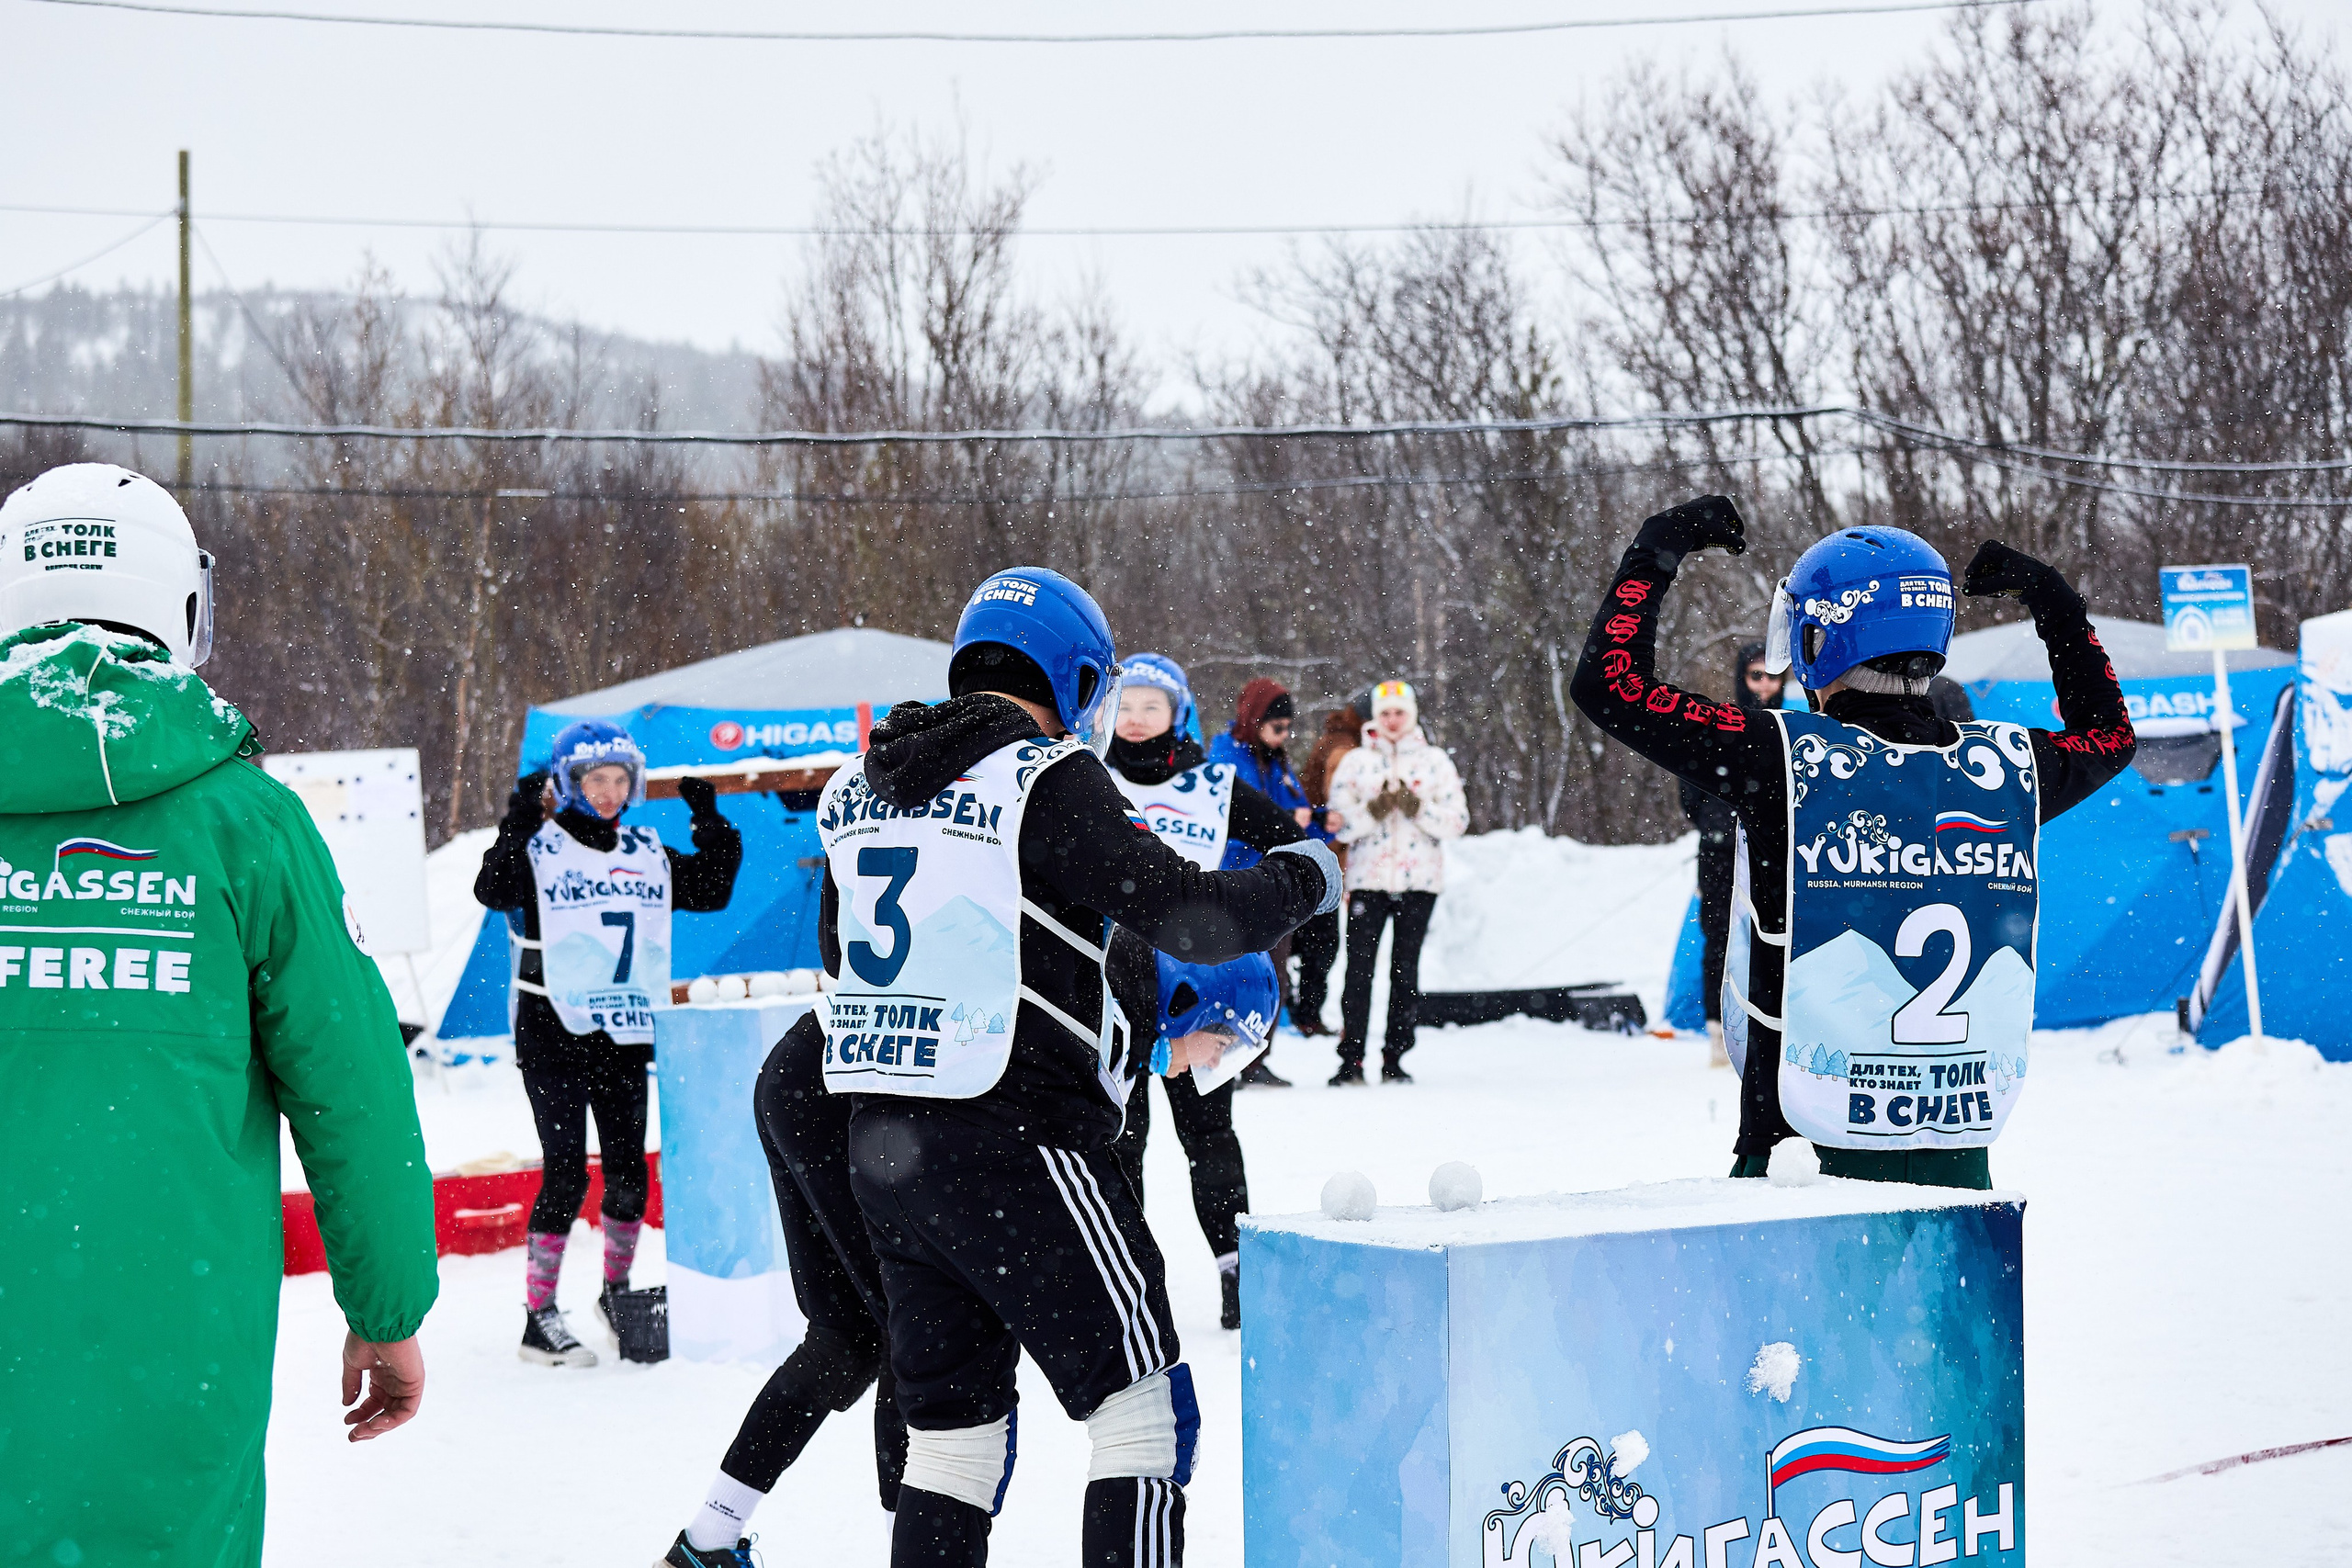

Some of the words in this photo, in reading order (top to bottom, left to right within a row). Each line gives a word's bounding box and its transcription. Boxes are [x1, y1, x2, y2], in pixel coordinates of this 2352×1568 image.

[62, 525, 116, 538] ТОЛК
[25, 545, 37, 561] В
[41, 539, 117, 558] СНЕГЕ
[1002, 580, 1039, 595] ТОЛК
[974, 593, 983, 605] В
[983, 589, 1036, 607] СНЕГЕ
[1901, 593, 1914, 607] В
[1915, 593, 1953, 610] СНЕГЕ
[942, 828, 985, 842] СНЕЖНЫЙ
[1144, 818, 1216, 841] SSEN
[1807, 880, 1841, 889] RUSSIA,
[1843, 880, 1888, 888] MURMANSK
[1889, 881, 1924, 890] REGION
[2017, 885, 2032, 894] БОЙ
[3, 905, 39, 913] REGION
[120, 907, 172, 918] СНЕЖНЫЙ
[174, 909, 196, 920] БОЙ
[848, 847, 919, 987] 3
[600, 911, 634, 984] 7
[1892, 903, 1972, 1045] 2
[842, 1004, 869, 1017] ТЕХ,
[874, 1004, 944, 1032] ТОЛК
[836, 1019, 866, 1029] ЗНАЕТ
[825, 1033, 834, 1065] В
[839, 1032, 940, 1068] СНЕГЕ
[1849, 1063, 1885, 1077] ДЛЯ
[1887, 1065, 1922, 1078] ТЕХ,
[1929, 1060, 1986, 1089] ТОЛК
[1849, 1077, 1877, 1089] КТО
[1879, 1079, 1922, 1090] ЗНАЕТ
[1848, 1092, 1876, 1125] В
[1886, 1090, 1993, 1127] СНЕГЕ
